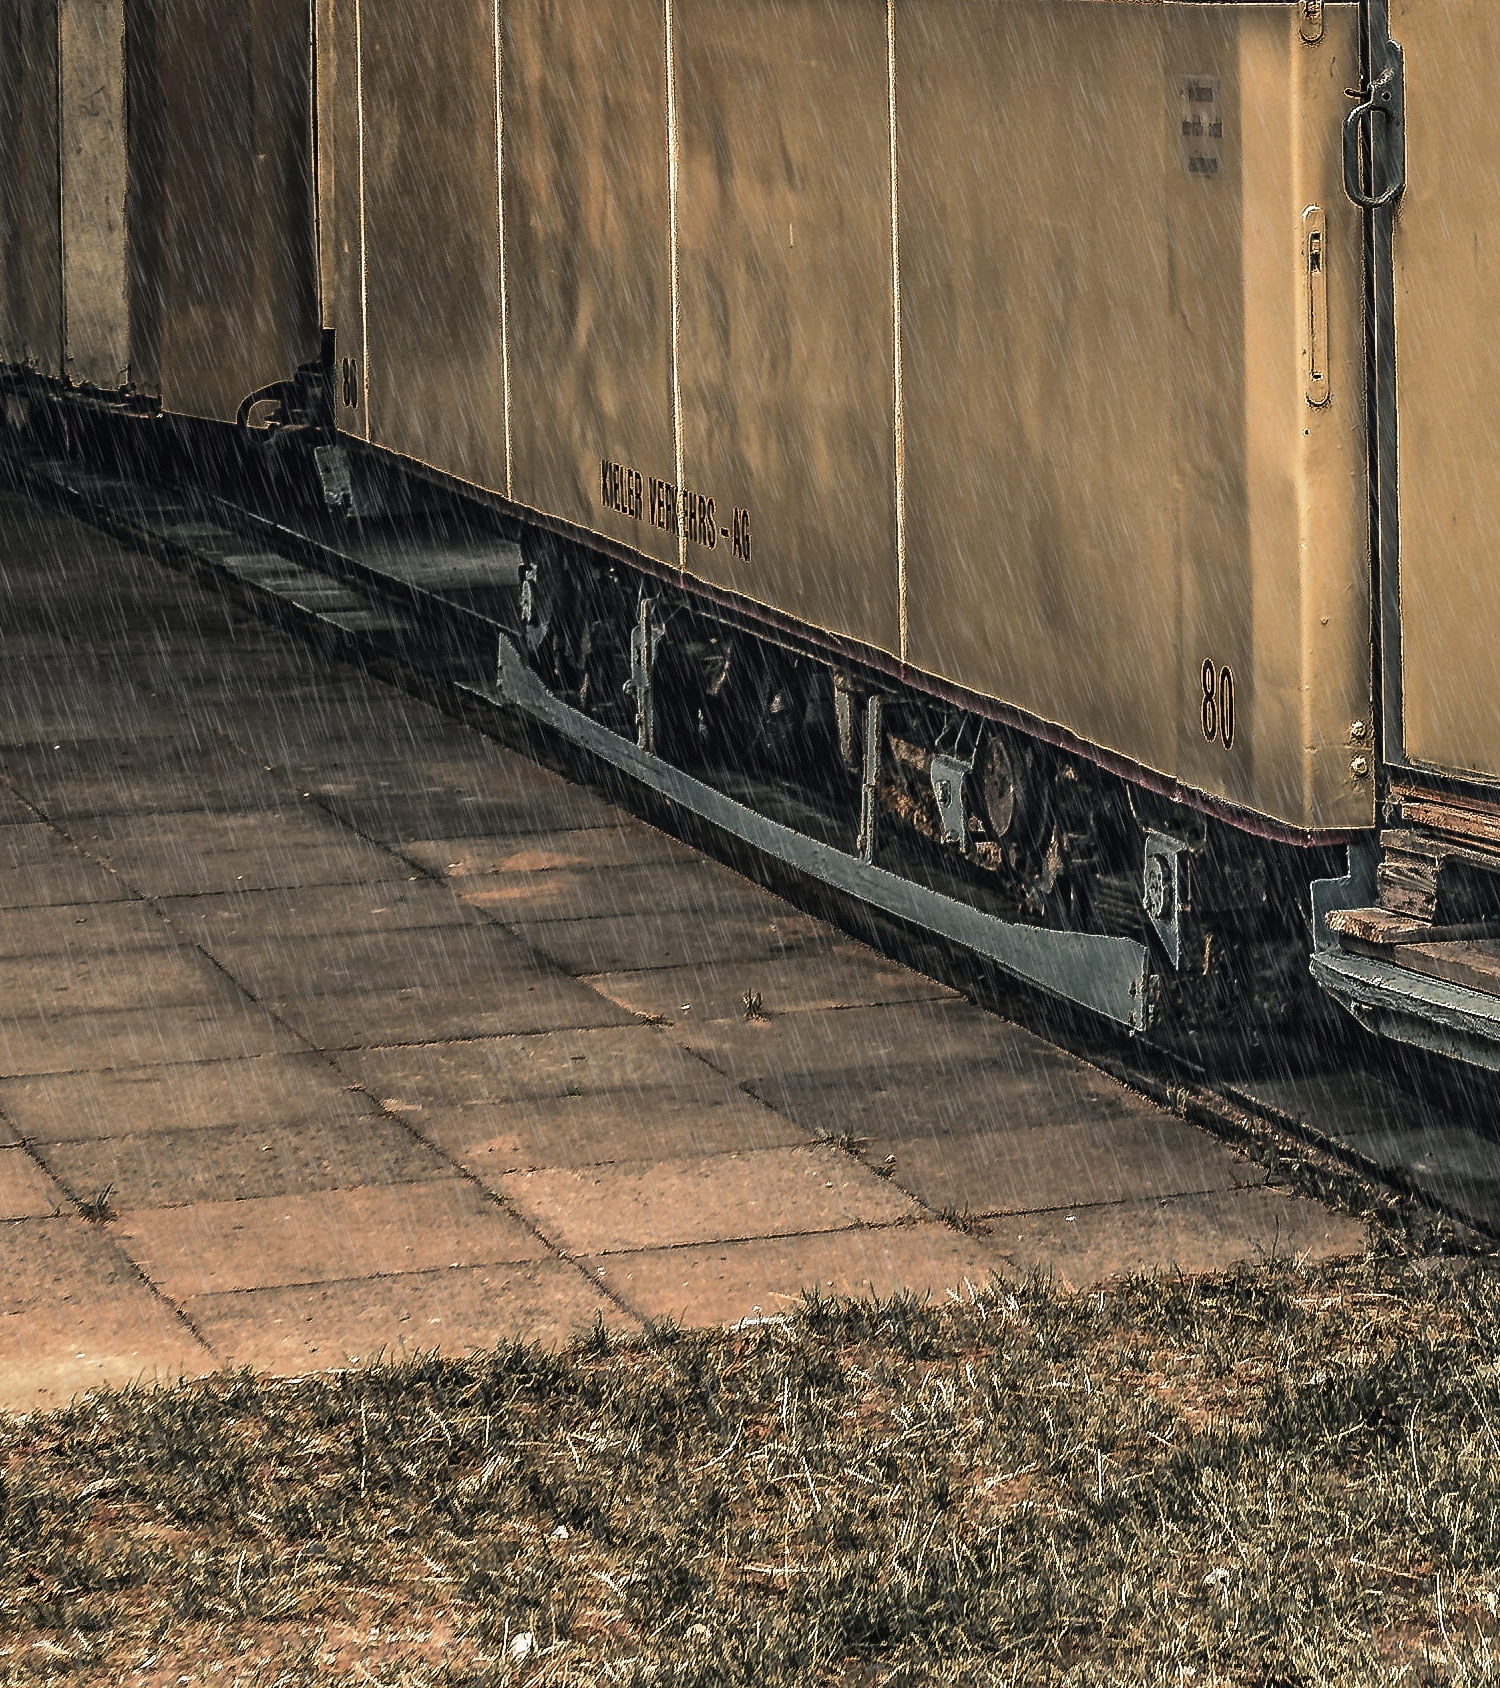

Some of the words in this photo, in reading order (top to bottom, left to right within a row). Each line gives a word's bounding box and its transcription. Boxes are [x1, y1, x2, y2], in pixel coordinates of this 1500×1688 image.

[600, 458, 644, 521] KIELER
[731, 506, 752, 564] AG
[1200, 657, 1236, 751] 80
